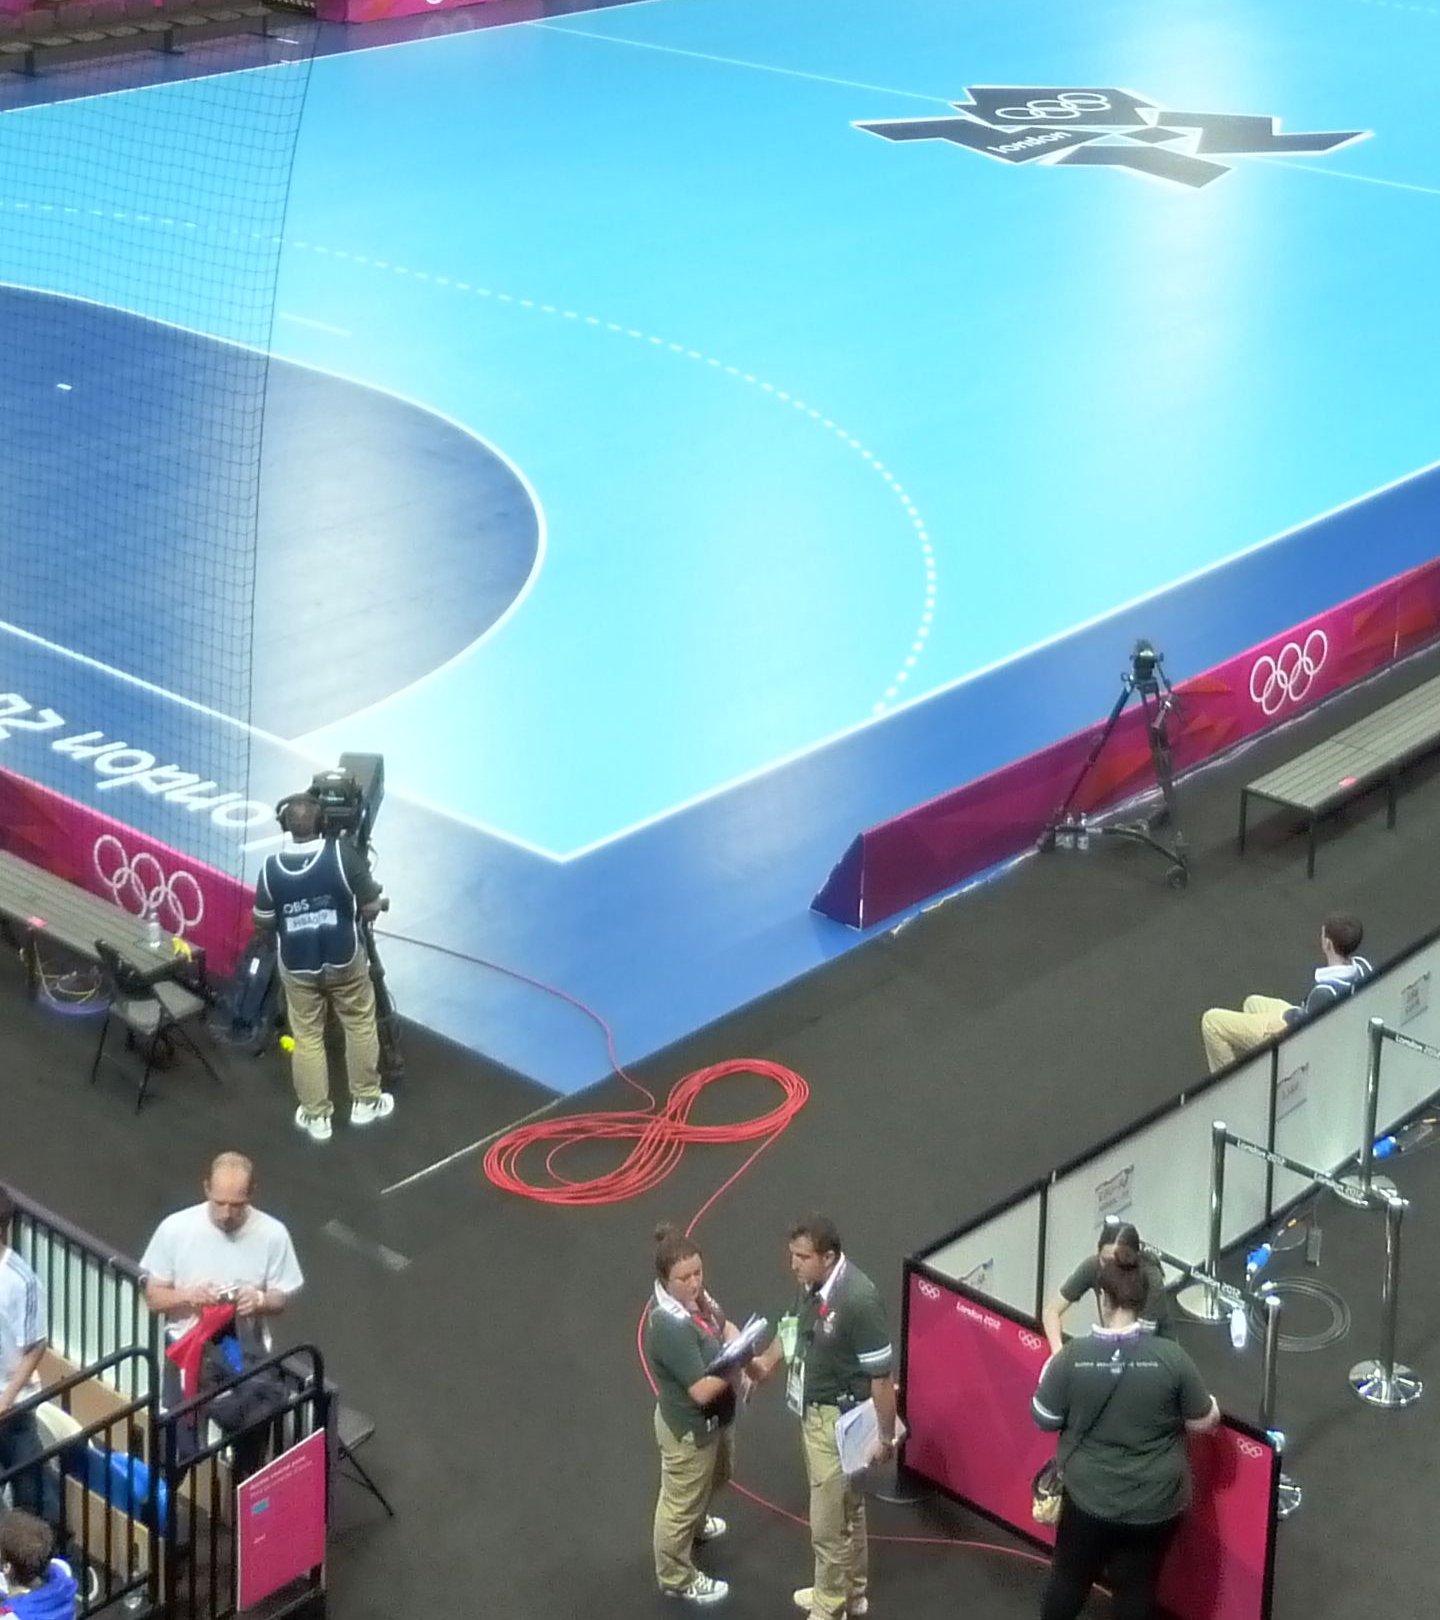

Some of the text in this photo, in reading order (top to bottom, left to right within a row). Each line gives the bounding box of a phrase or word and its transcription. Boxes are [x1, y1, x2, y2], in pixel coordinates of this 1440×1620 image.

[986, 131, 1072, 154] london
[283, 898, 310, 915] OBS
[1236, 1139, 1286, 1167] London 2012
[1313, 1171, 1365, 1201] London 2012
[1190, 1267, 1241, 1298] London 2012
[956, 1301, 1002, 1331] London 2012
